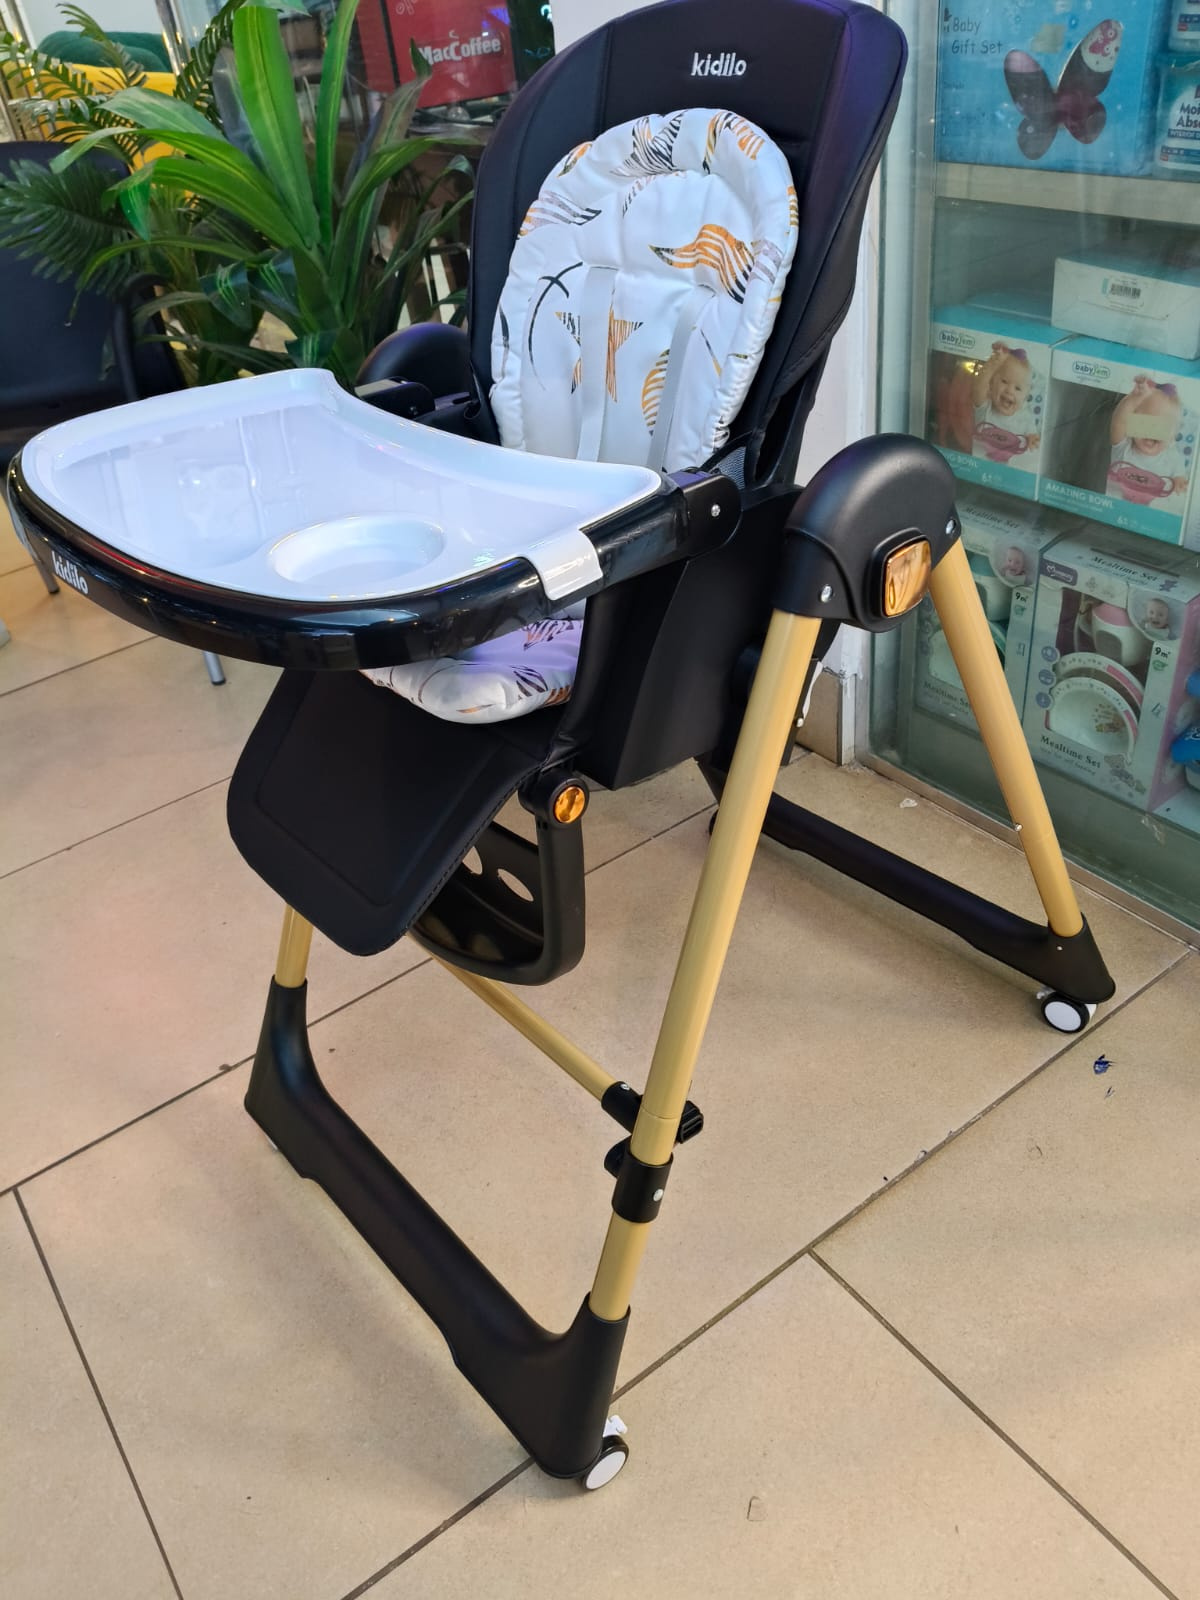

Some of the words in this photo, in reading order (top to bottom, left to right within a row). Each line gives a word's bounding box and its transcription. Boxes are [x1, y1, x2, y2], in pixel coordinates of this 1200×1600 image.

[952, 16, 982, 36] Baby
[418, 38, 501, 65] MacCoffee
[951, 39, 976, 54] Gift
[981, 40, 1003, 54] Set
[690, 52, 747, 76] kidilo
[1045, 482, 1087, 501] AMAZING
[1088, 495, 1114, 509] BOWL
[51, 550, 89, 594] kidilo
[1040, 735, 1083, 760] Mealtime
[1086, 755, 1101, 769] Set
